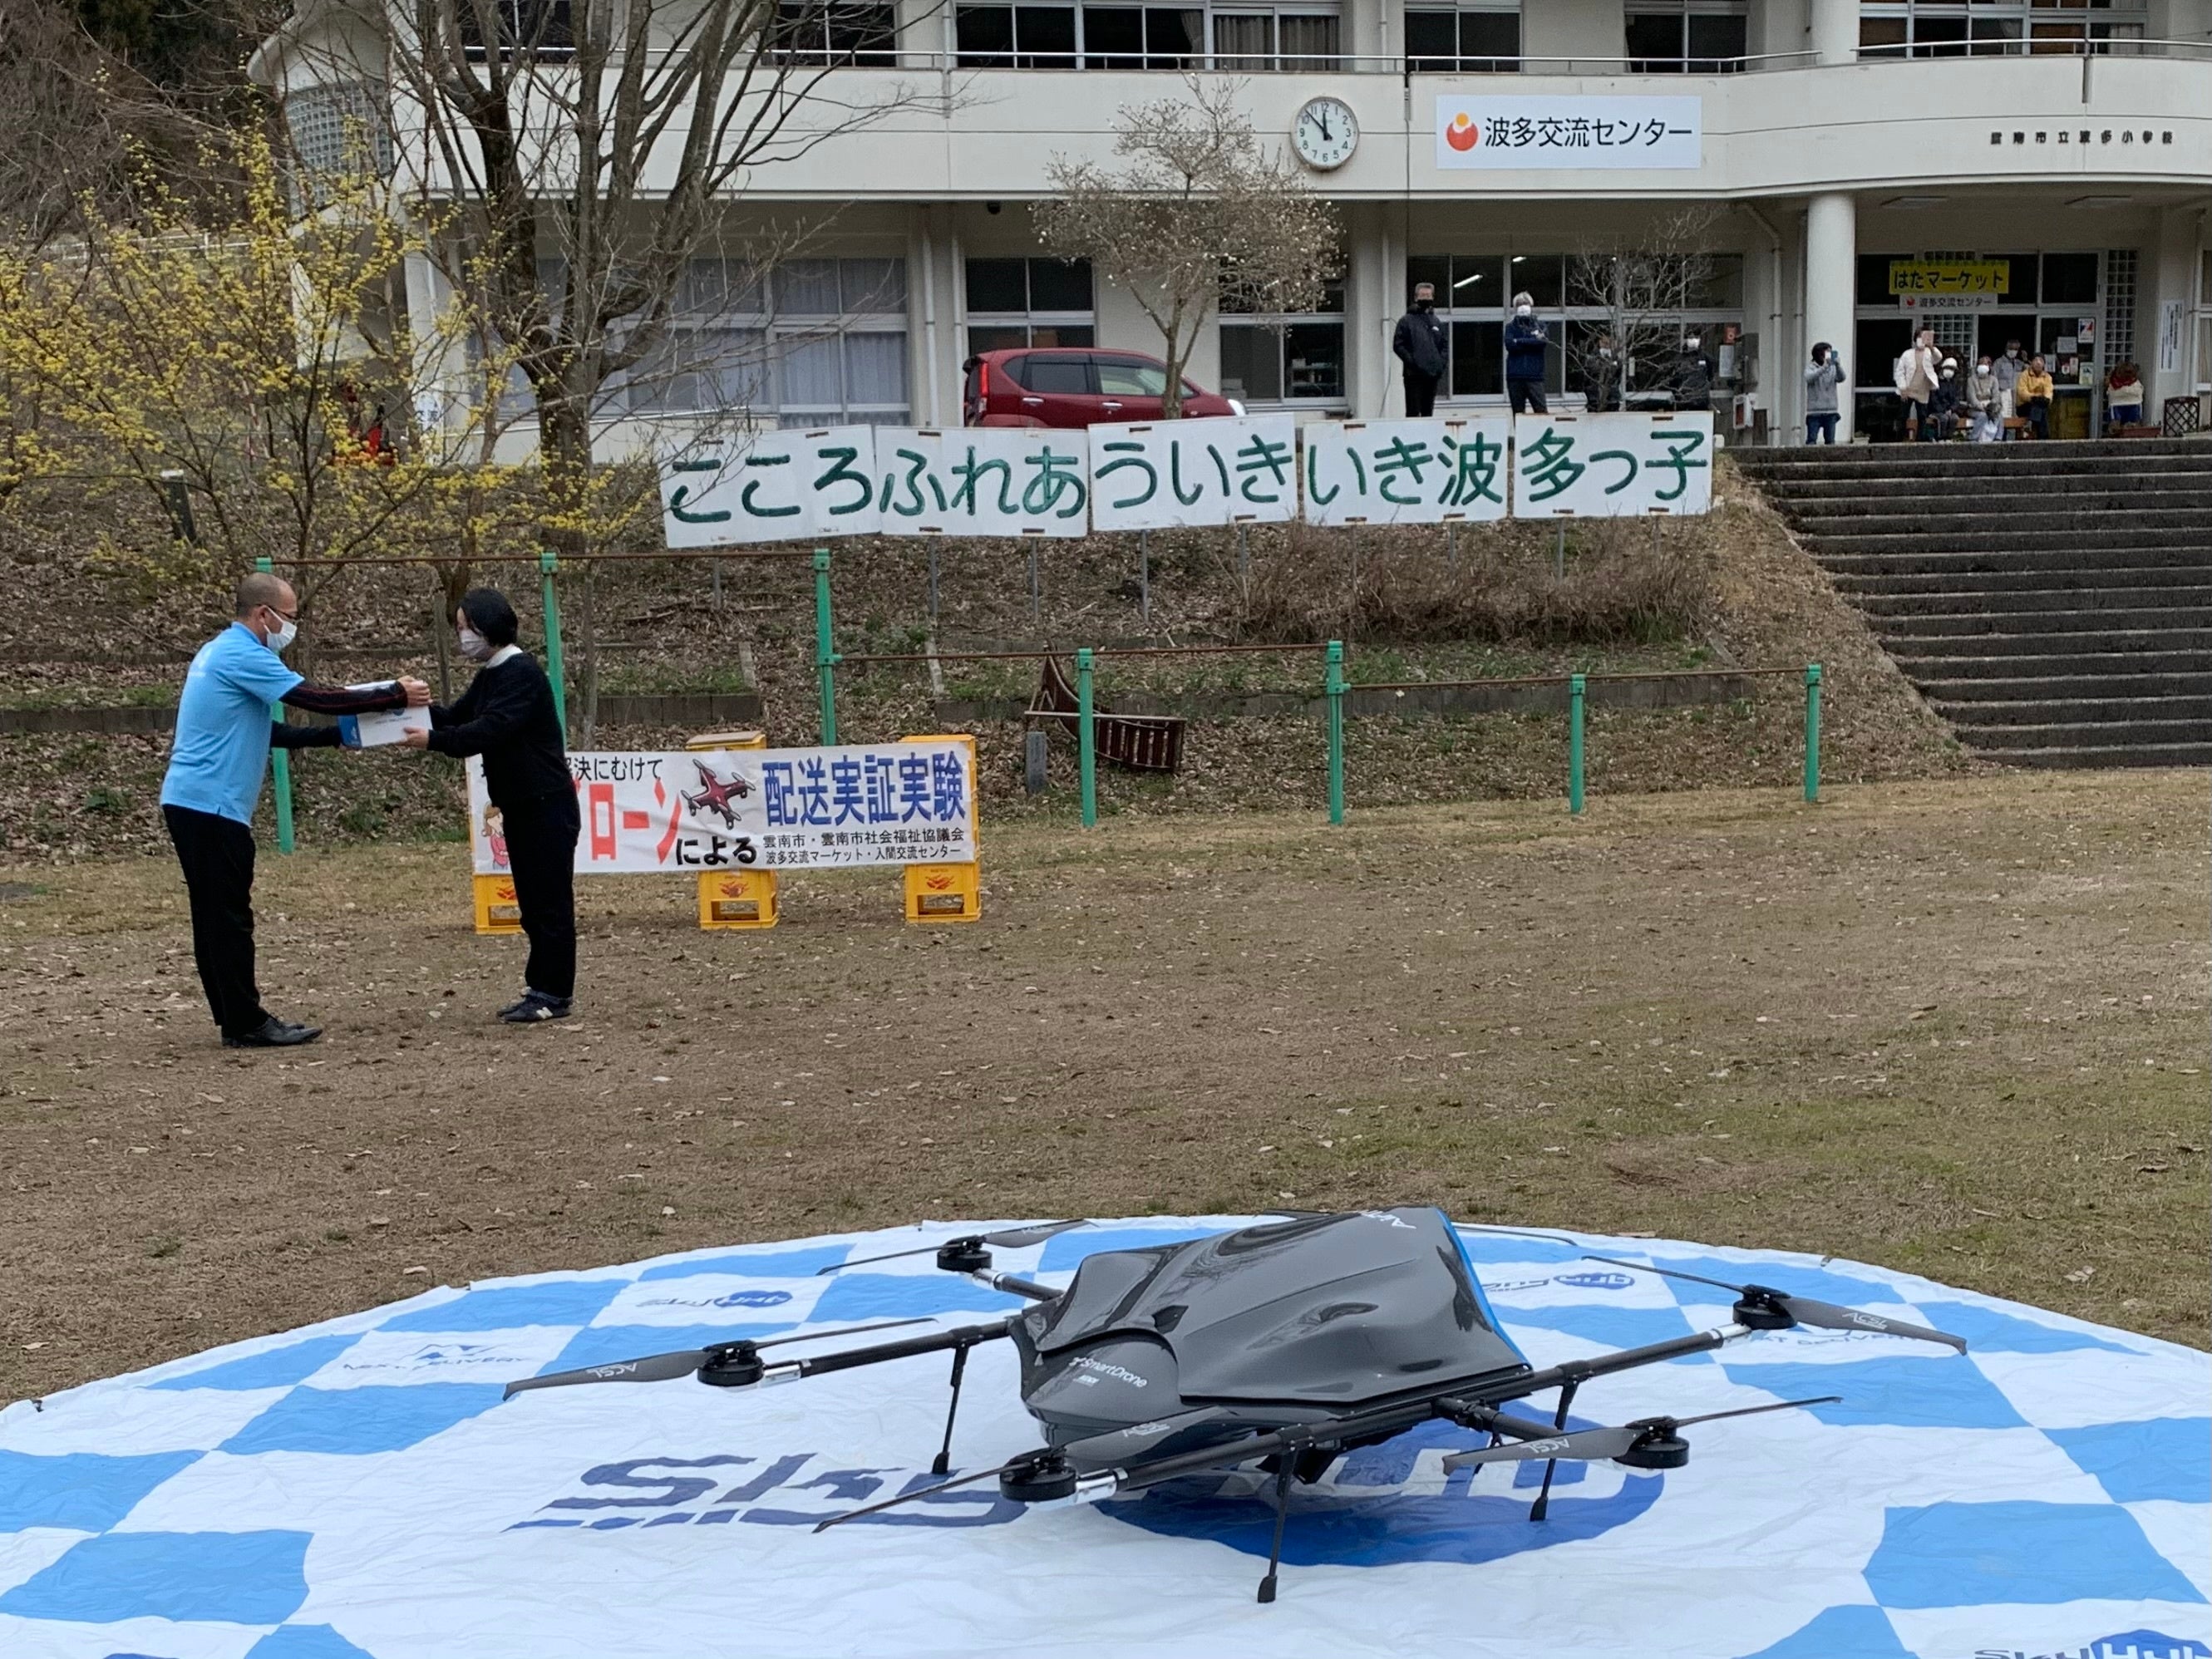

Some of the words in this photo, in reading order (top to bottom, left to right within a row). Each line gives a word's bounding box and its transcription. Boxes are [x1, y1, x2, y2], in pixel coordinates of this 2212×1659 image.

[1485, 116, 1692, 148] 波多交流センター
[1894, 269, 2004, 289] はたマーケット
[763, 751, 967, 828] 配送実証実験
[572, 776, 682, 865] ローン
[762, 828, 965, 849] 雲南市・雲南市社会福祉協議会
[676, 835, 757, 866] による
[1841, 1312, 1888, 1329] ACSL
[586, 1362, 638, 1378] ACSL
[1520, 1438, 1570, 1454] ACSL
